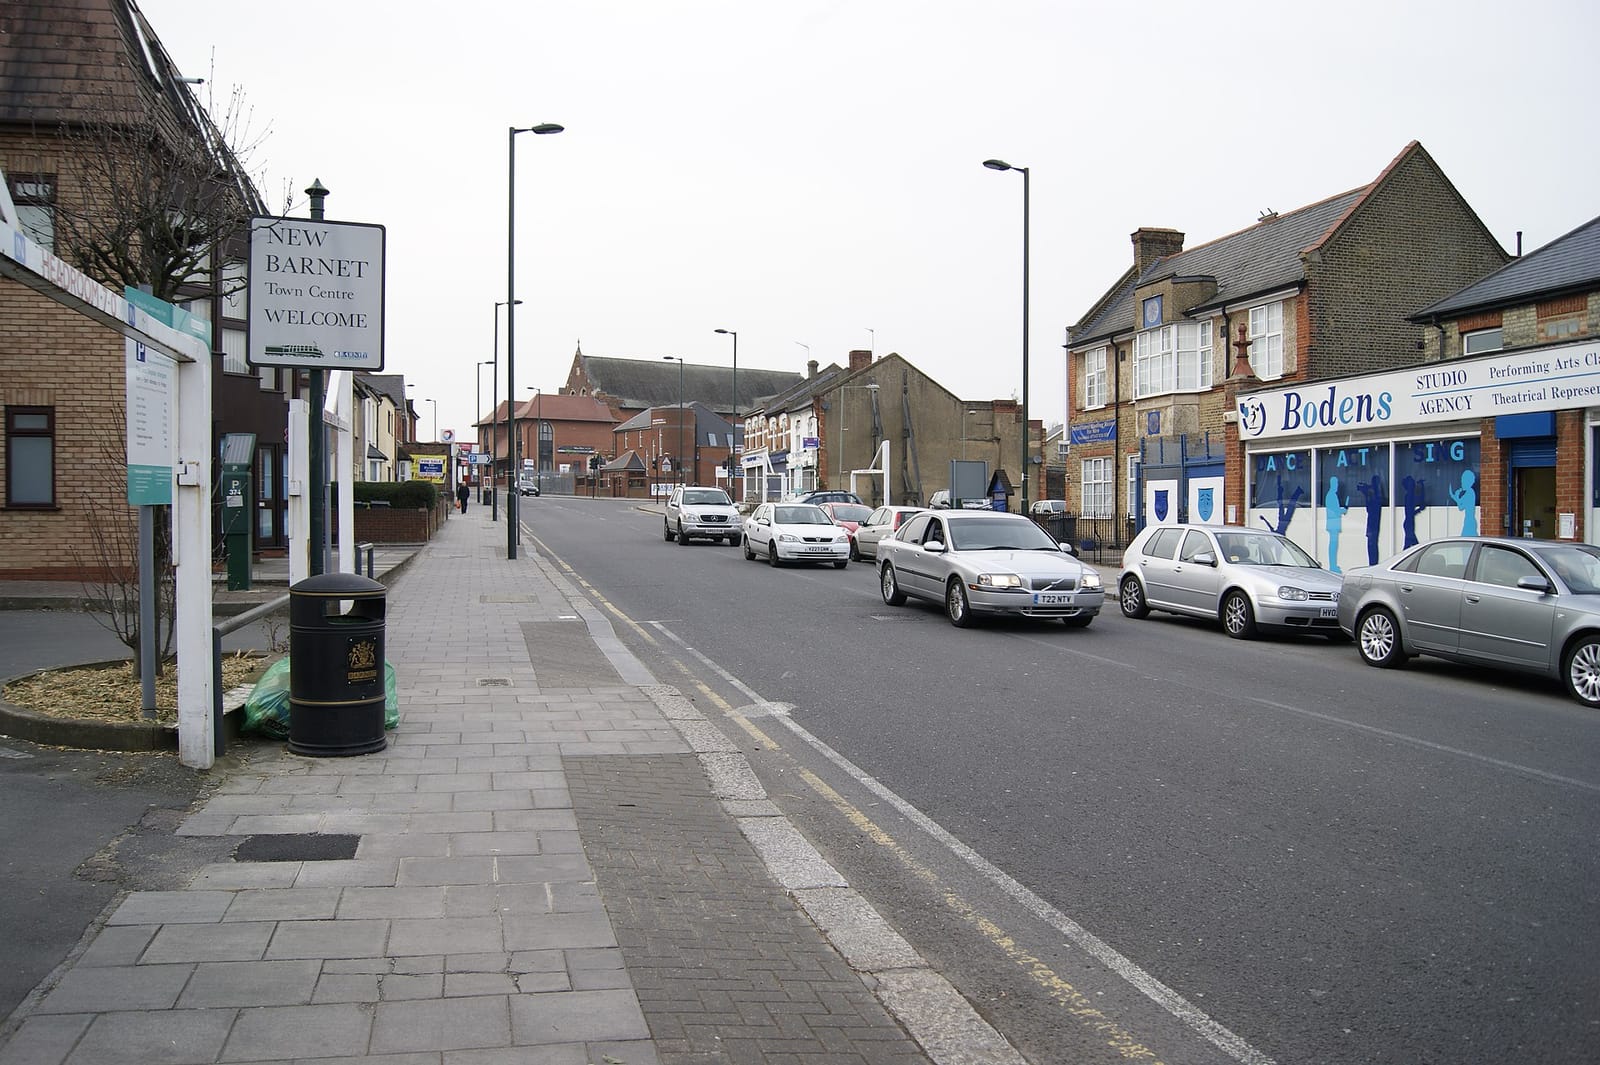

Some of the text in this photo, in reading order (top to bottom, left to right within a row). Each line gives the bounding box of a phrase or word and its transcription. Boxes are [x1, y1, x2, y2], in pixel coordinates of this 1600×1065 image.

[268, 227, 329, 247] NEW
[265, 254, 369, 278] BARNET
[42, 249, 99, 308] HEADROOM
[264, 282, 354, 300] Town Centre
[264, 308, 368, 329] WELCOME
[1489, 361, 1550, 379] Performing
[1554, 356, 1580, 370] Arts
[1416, 369, 1467, 391] STUDIO
[1419, 395, 1473, 416] AGENCY
[1492, 388, 1547, 405] Theatrical
[1281, 386, 1393, 431] Bodens
[232, 480, 240, 489] P
[1042, 595, 1056, 603] T22
[1322, 609, 1339, 617] HV0
